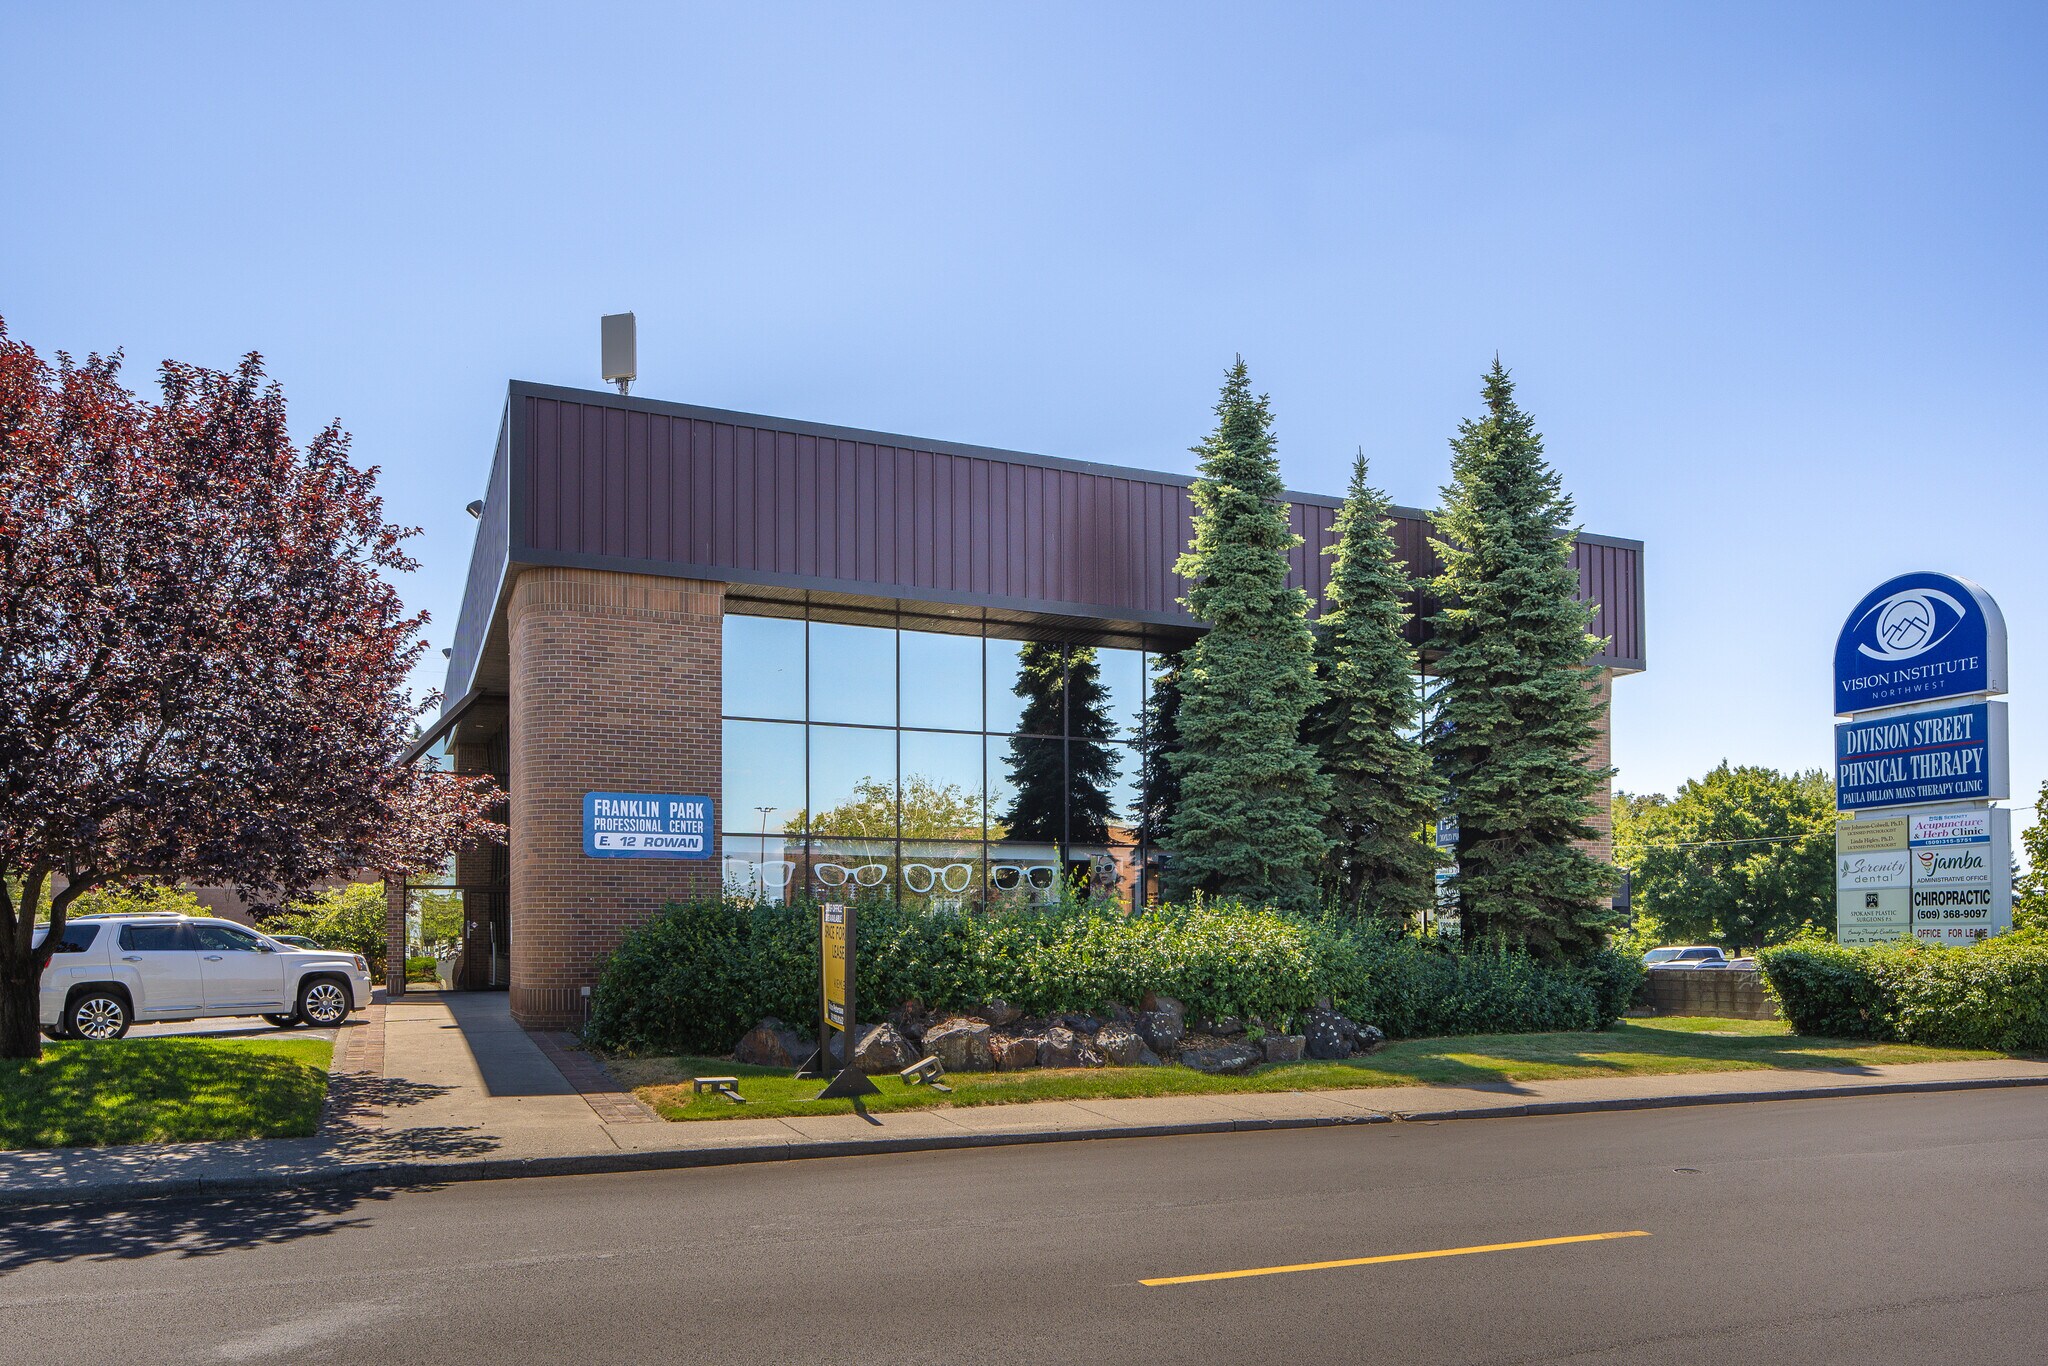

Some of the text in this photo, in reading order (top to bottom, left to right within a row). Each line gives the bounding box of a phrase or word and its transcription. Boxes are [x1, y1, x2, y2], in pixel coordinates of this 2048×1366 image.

[1842, 656, 1979, 692] VISION INSTITUTE
[1872, 680, 1945, 699] NORTHWEST
[1846, 713, 1973, 755] DIVISION STREET
[1839, 747, 1983, 788] PHYSICAL THERAPY
[1843, 780, 1983, 804] PAULA DILLON MAYS THERAPY CLINIC
[594, 799, 704, 819] FRANKLIN PARK
[594, 817, 704, 833] PROFESSIONAL CENTER
[1914, 819, 1983, 830] Acupuncture
[1923, 830, 1949, 839] Herb
[1951, 827, 1984, 837] Clinic
[599, 836, 699, 849] E. 12 ROWAN
[1847, 858, 1908, 876] Serenity
[1926, 851, 1984, 877] jamba
[1854, 874, 1893, 883] dental
[1914, 889, 1991, 906] CHIROPRACTIC
[1917, 909, 1988, 920] (509) 368-9097
[1917, 929, 1941, 938] OFFICE
[1948, 929, 1962, 938] FOR
